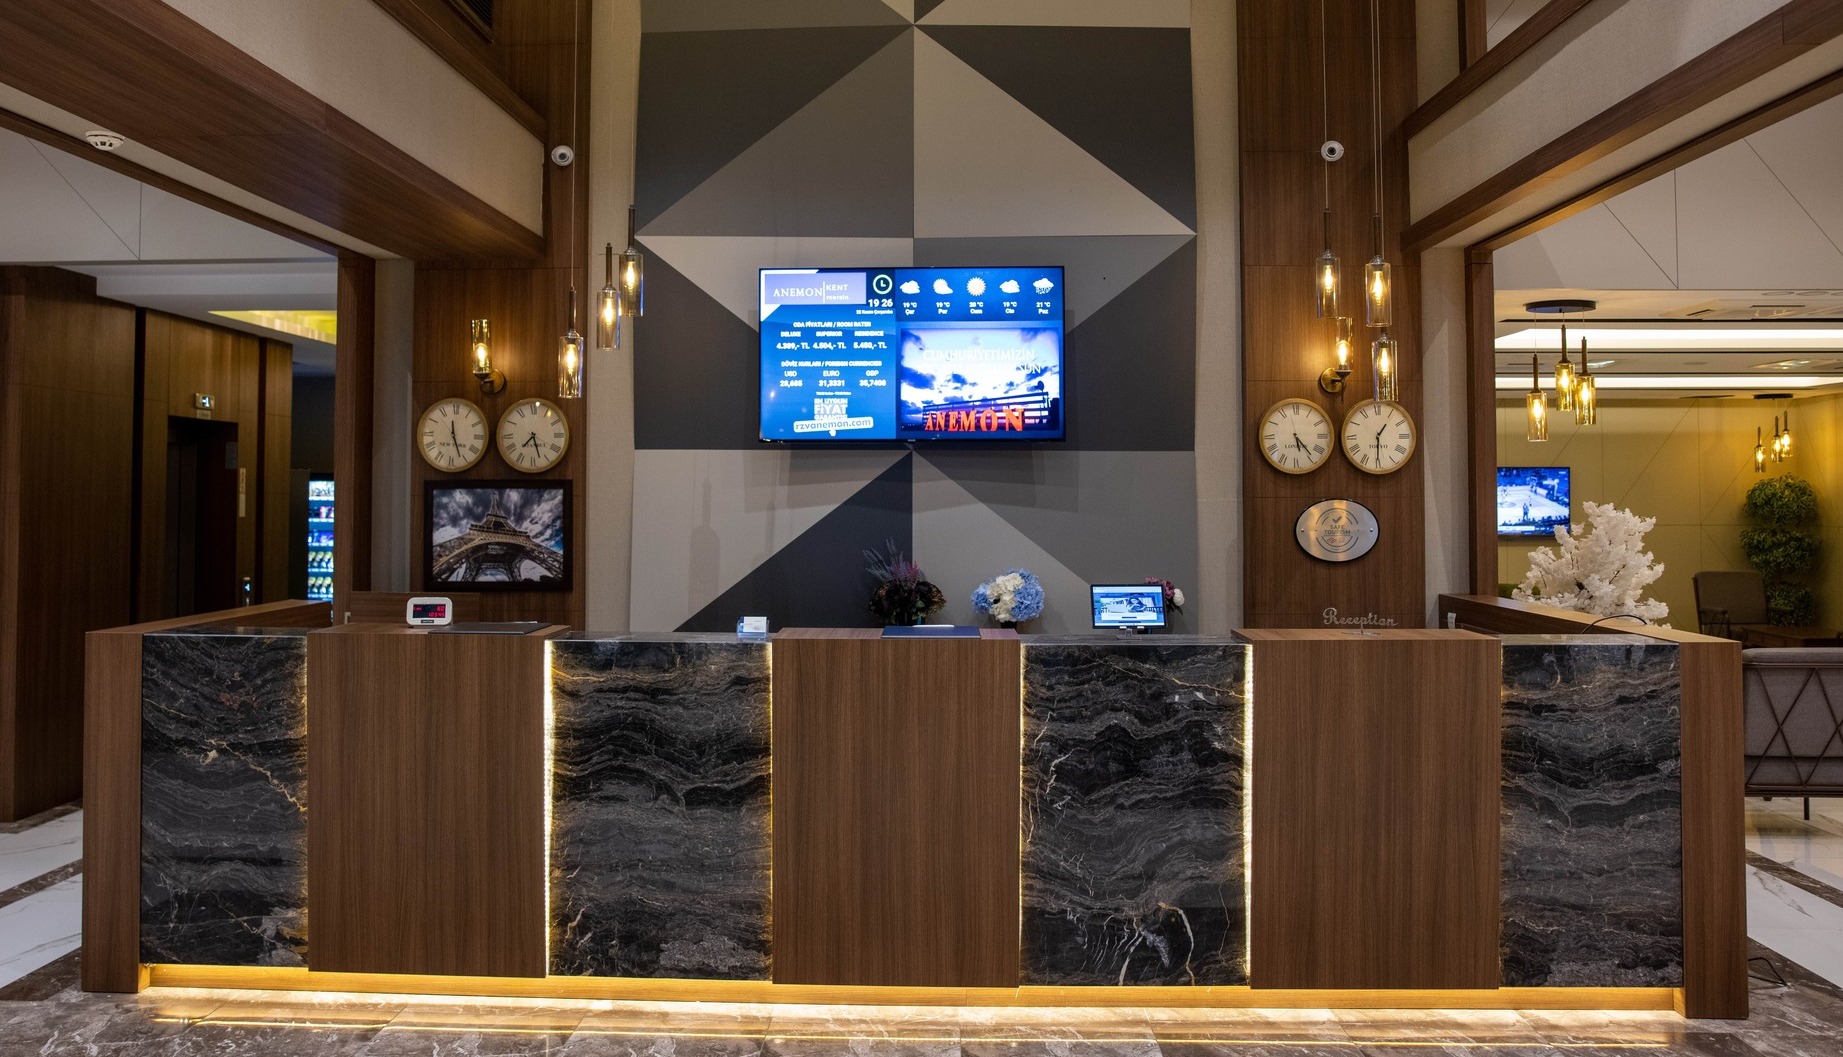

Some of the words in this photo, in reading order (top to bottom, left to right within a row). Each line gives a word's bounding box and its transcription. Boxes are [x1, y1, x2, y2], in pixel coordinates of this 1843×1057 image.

[773, 287, 823, 297] ANEMON
[868, 299, 880, 308] 19
[881, 299, 893, 308] 26
[814, 403, 847, 415] FİYAT
[795, 419, 871, 430] rzvanemon.com
[925, 408, 1025, 432] ANEMON
[1322, 607, 1399, 628] Reception
